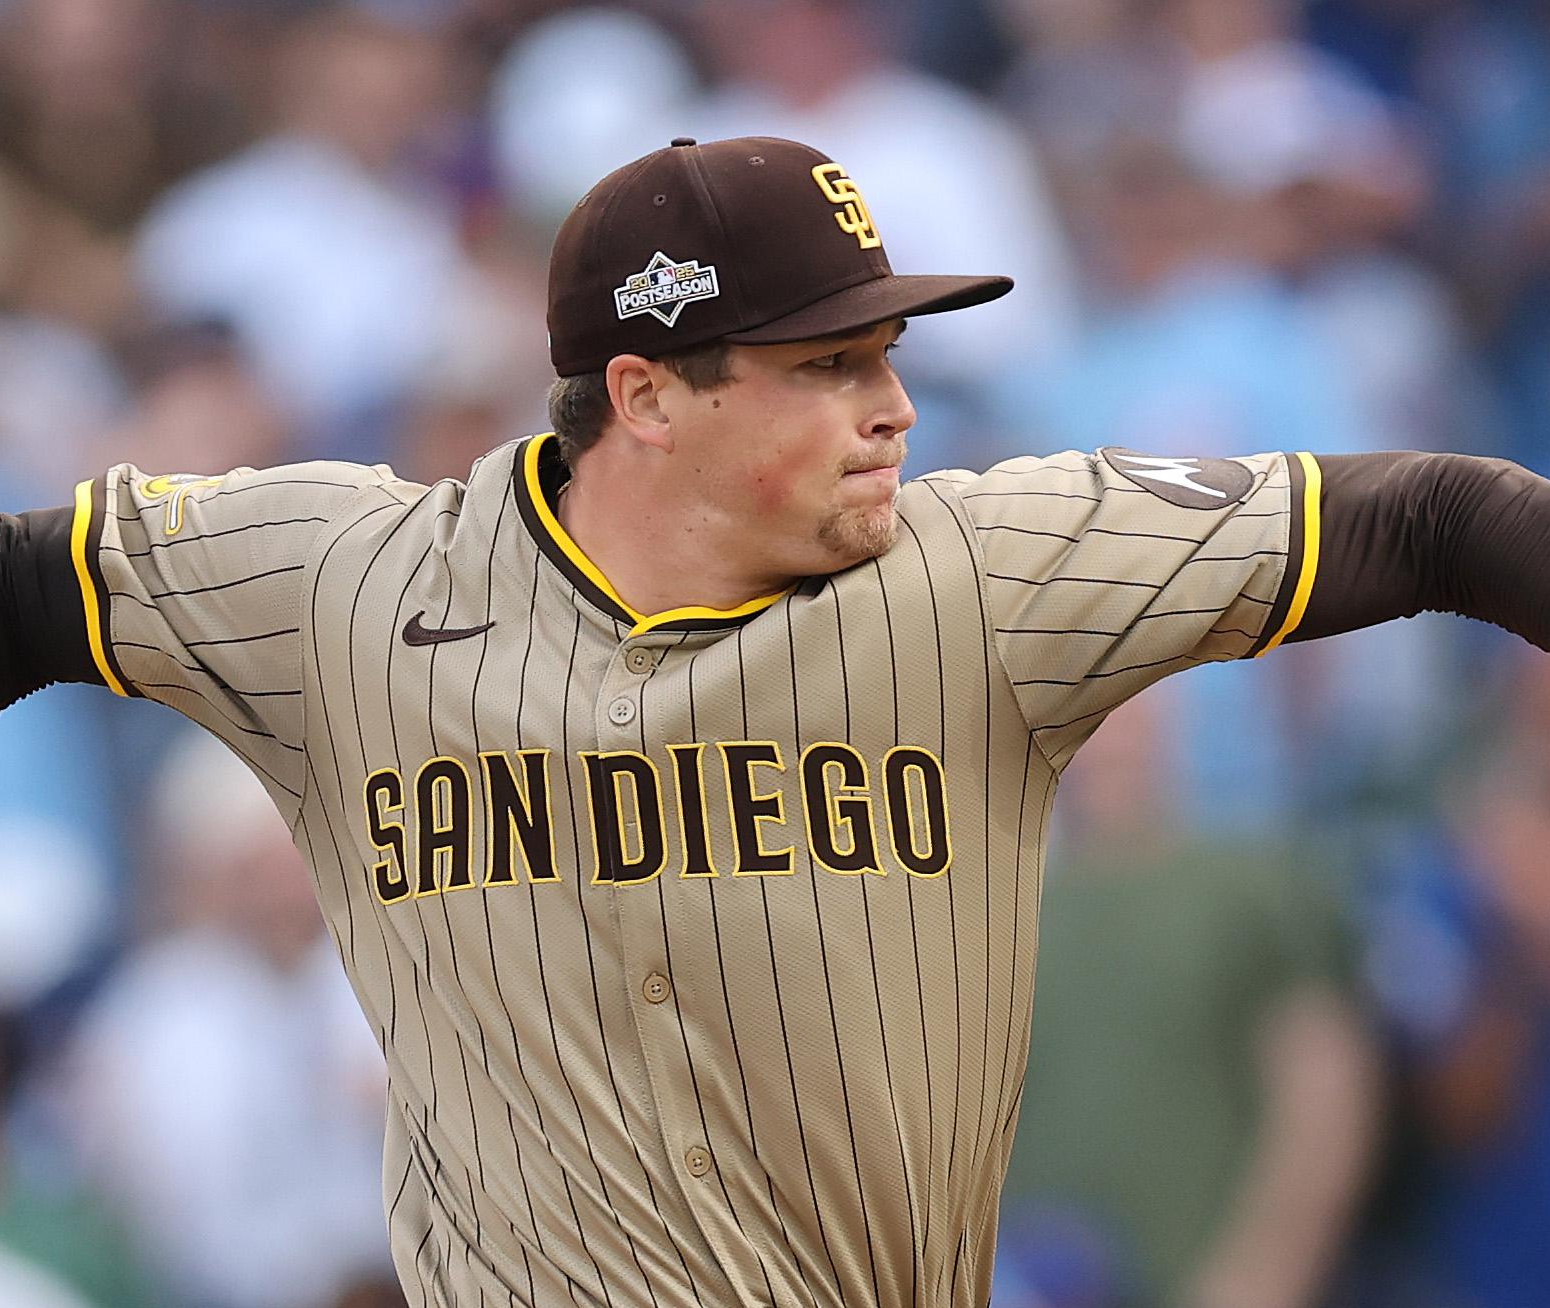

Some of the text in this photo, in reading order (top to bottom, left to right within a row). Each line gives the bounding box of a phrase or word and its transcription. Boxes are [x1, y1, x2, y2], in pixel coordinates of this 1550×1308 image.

[619, 275, 713, 311] POSTSEASON
[363, 740, 953, 906] SAN DIEGO
